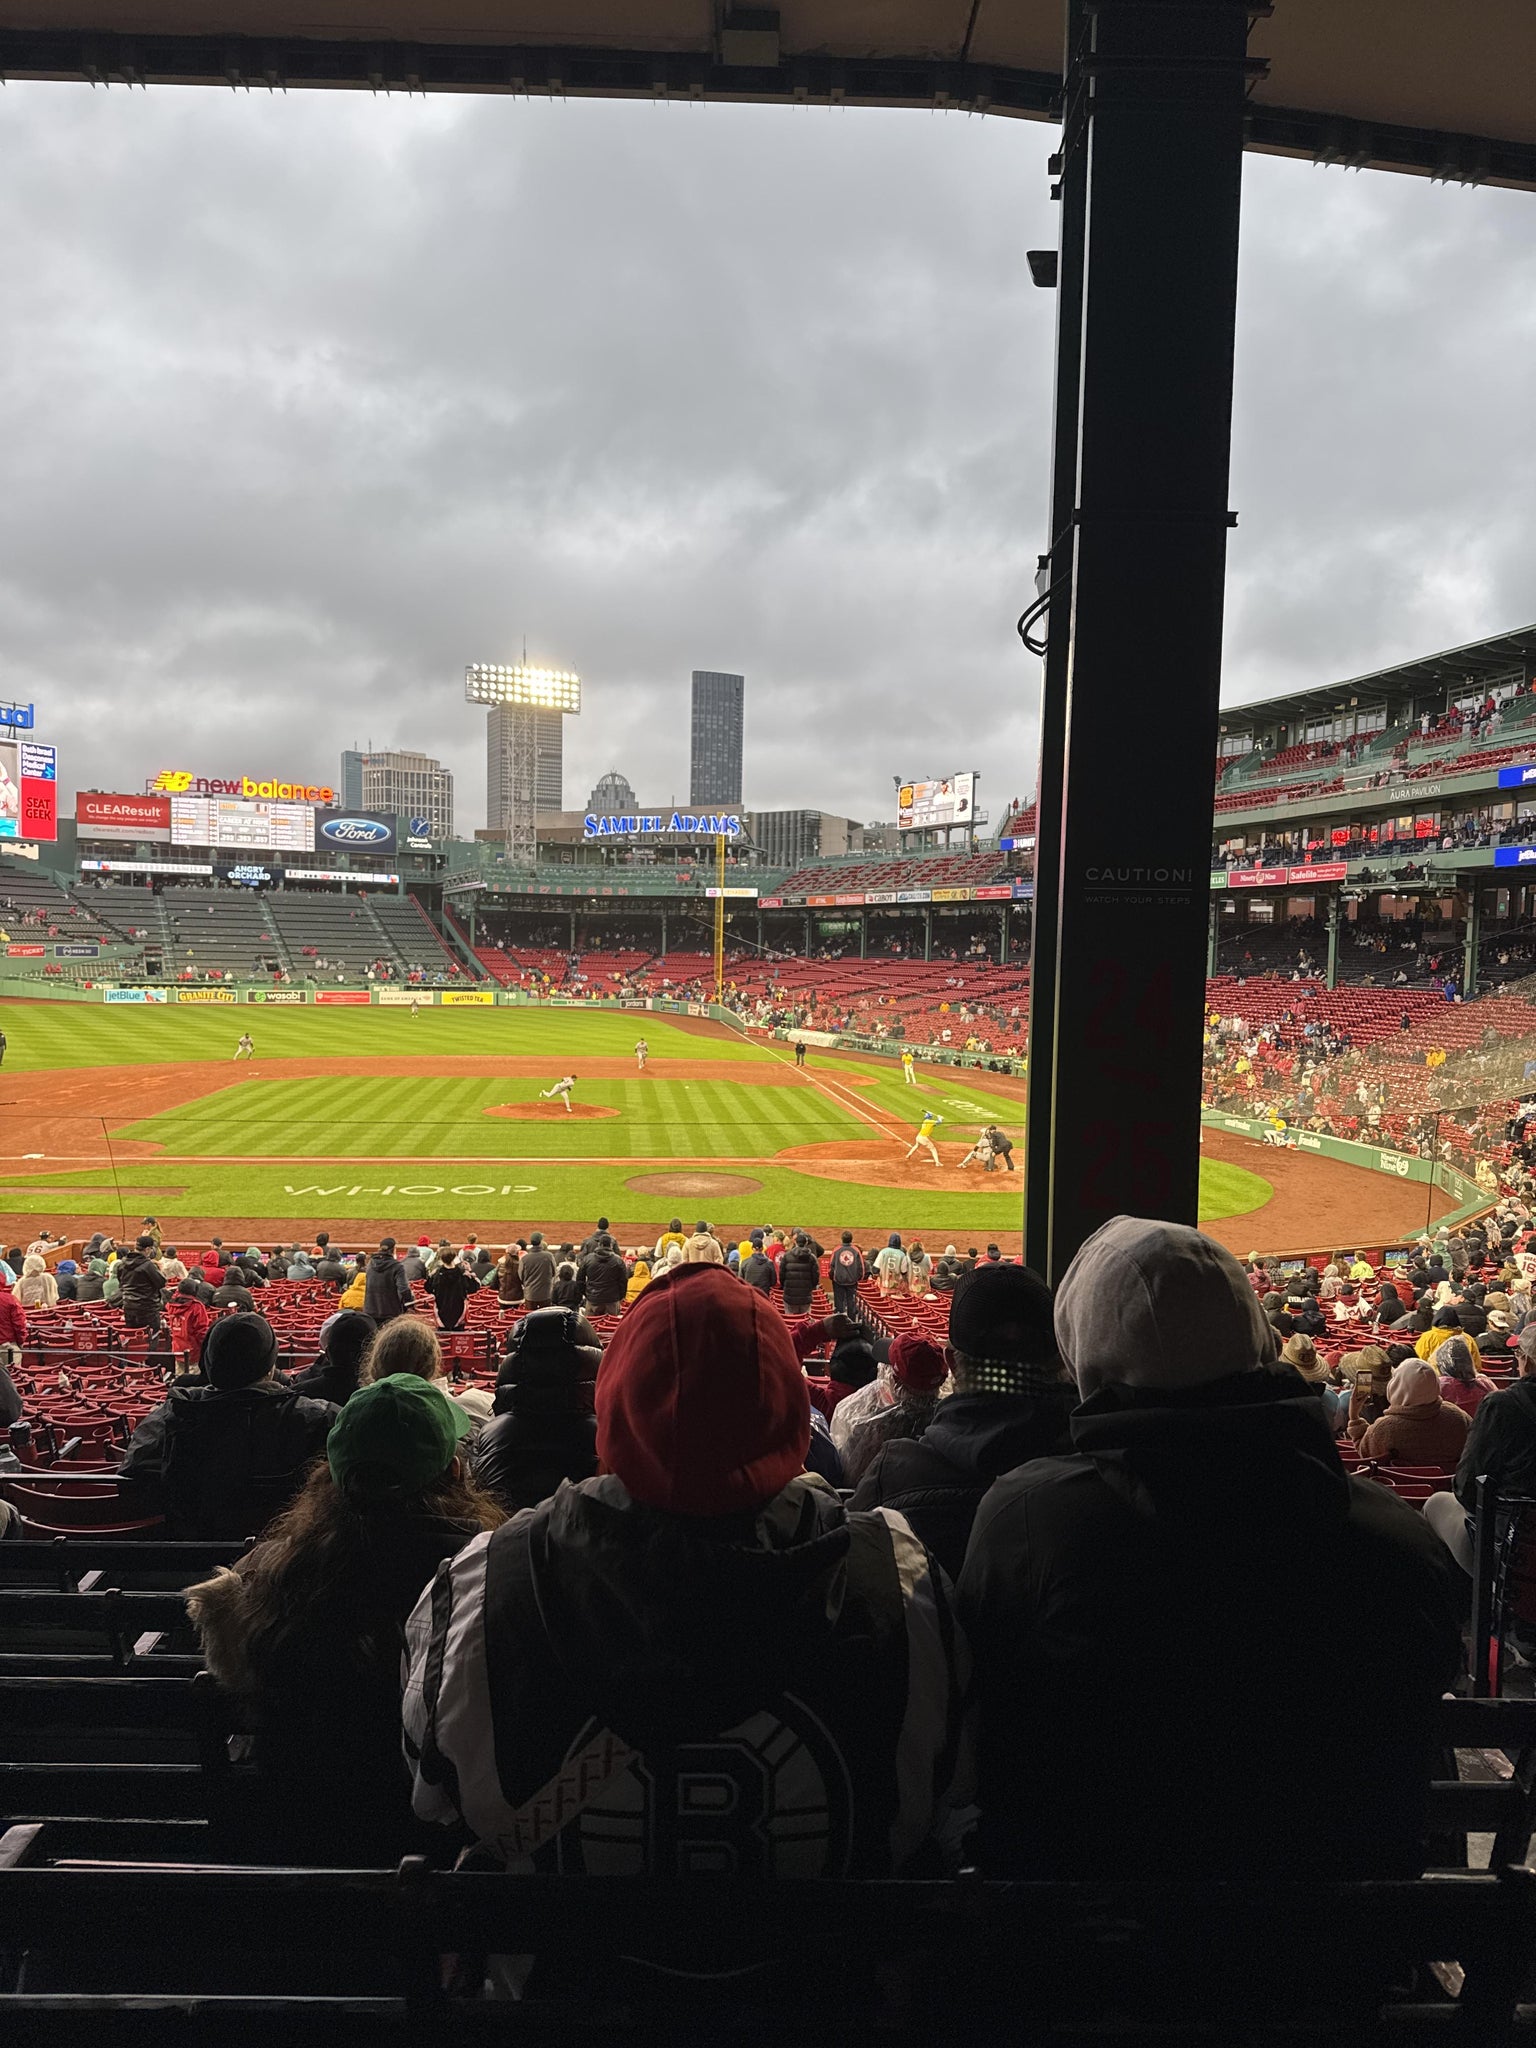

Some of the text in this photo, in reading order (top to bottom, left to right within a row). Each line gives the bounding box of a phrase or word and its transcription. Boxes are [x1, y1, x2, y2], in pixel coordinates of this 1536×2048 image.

[0, 703, 34, 729] ual
[152, 770, 334, 802] NB new balance
[1411, 785, 1441, 798] PAVILION
[27, 797, 51, 810] SEAT
[26, 808, 51, 821] GEEK
[86, 803, 162, 817] CLEAResult
[335, 821, 377, 840] Ford
[584, 811, 740, 838] SAMUEL ADAMS
[234, 865, 264, 873] ANGRY
[1085, 867, 1192, 882] CAUTION!
[1290, 870, 1317, 880] Safelite
[227, 871, 271, 881] ORCHARD
[1085, 896, 1119, 904] WATCH
[1125, 896, 1153, 904] YOUR
[22, 947, 45, 955] TICKET
[108, 991, 140, 1002] jetBlue
[179, 990, 236, 1002] GRANITE CITY
[266, 991, 300, 1000] wasabi
[451, 995, 484, 1003] TWISTED TEA
[1380, 1159, 1396, 1172] Nine
[284, 1184, 538, 1196] WHOOP
[887, 1256, 896, 1270] 5
[912, 1263, 921, 1274] 5
[1521, 1261, 1536, 1274] 16
[78, 1341, 93, 1350] 59
[455, 1345, 470, 1354] 57
